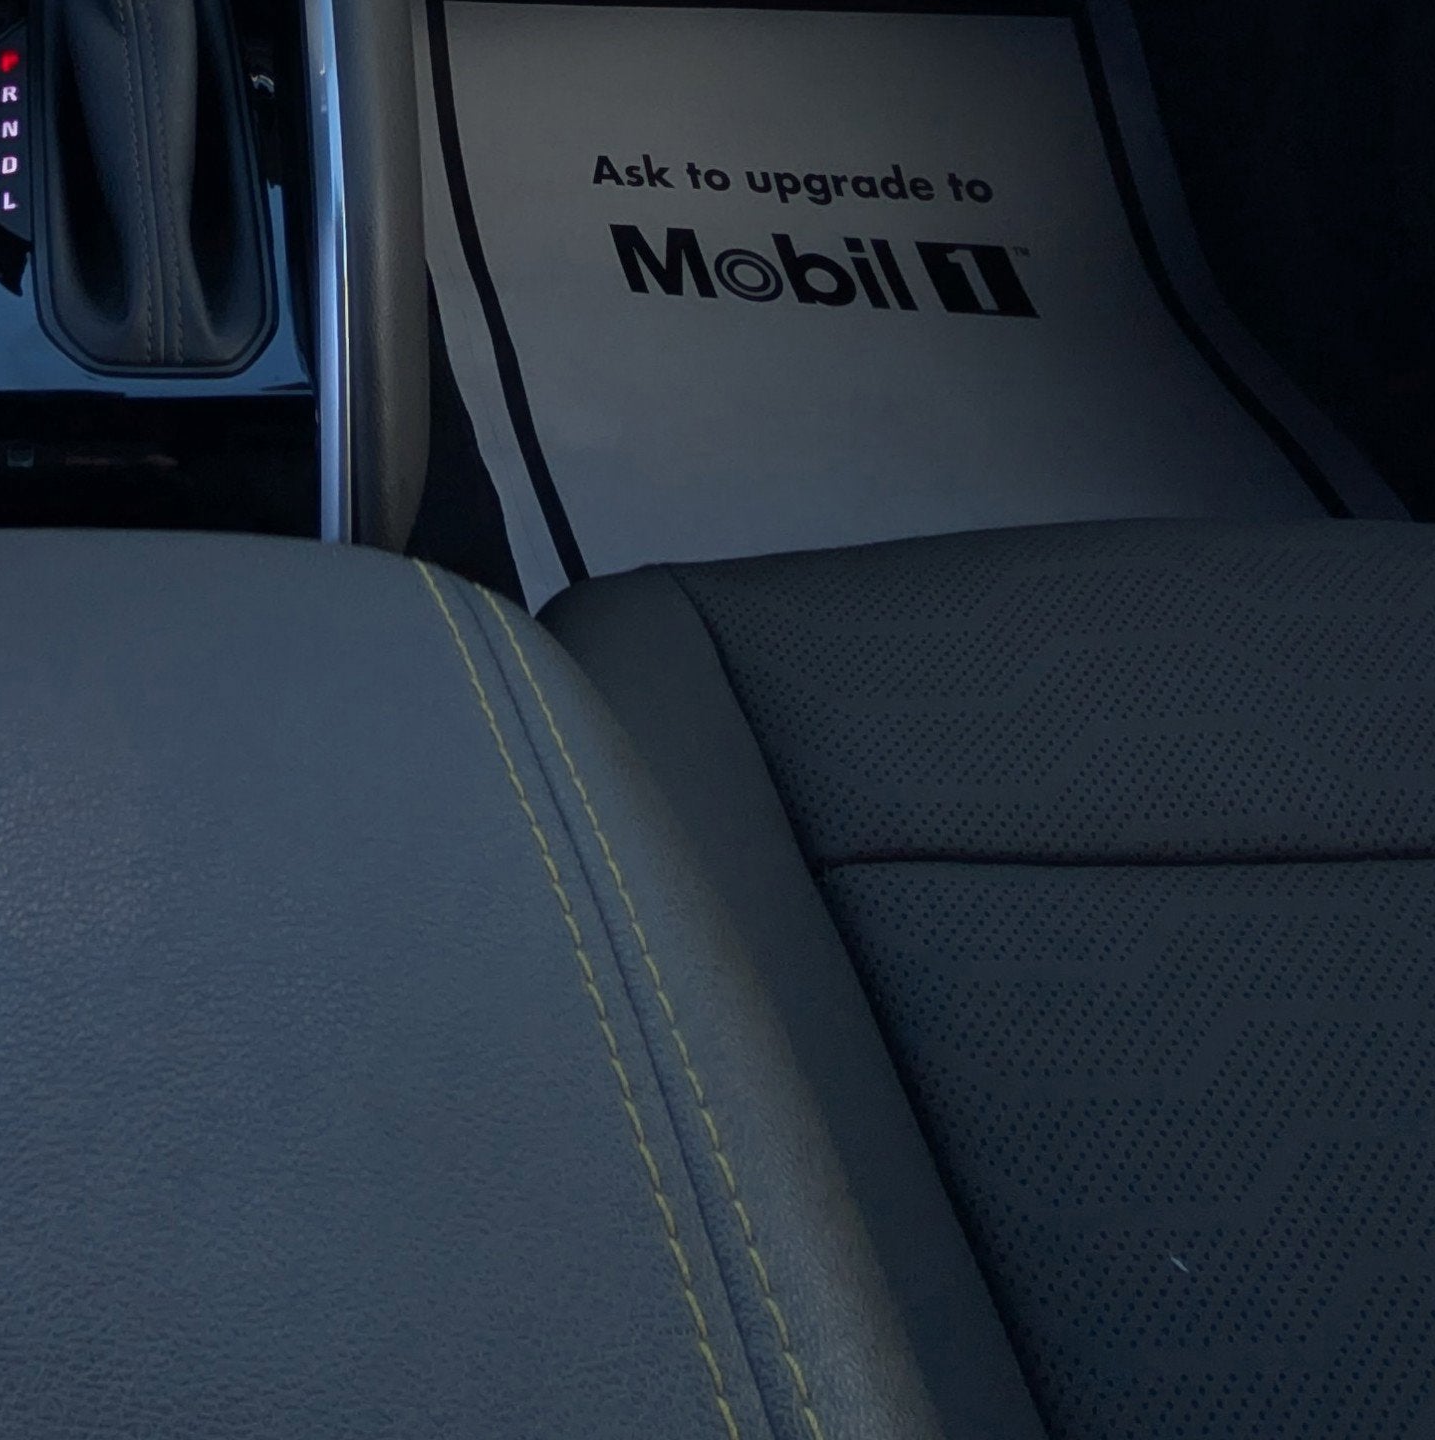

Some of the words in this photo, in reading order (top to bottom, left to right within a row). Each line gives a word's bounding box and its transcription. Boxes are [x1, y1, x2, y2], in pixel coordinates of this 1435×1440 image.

[2, 86, 18, 103] R
[2, 121, 18, 138] N
[2, 156, 18, 174] D
[592, 154, 674, 190] Ask
[686, 162, 730, 192] to
[746, 164, 935, 205] upgrade
[948, 173, 994, 203] to
[3, 192, 18, 210] L
[609, 223, 919, 311] Mobil
